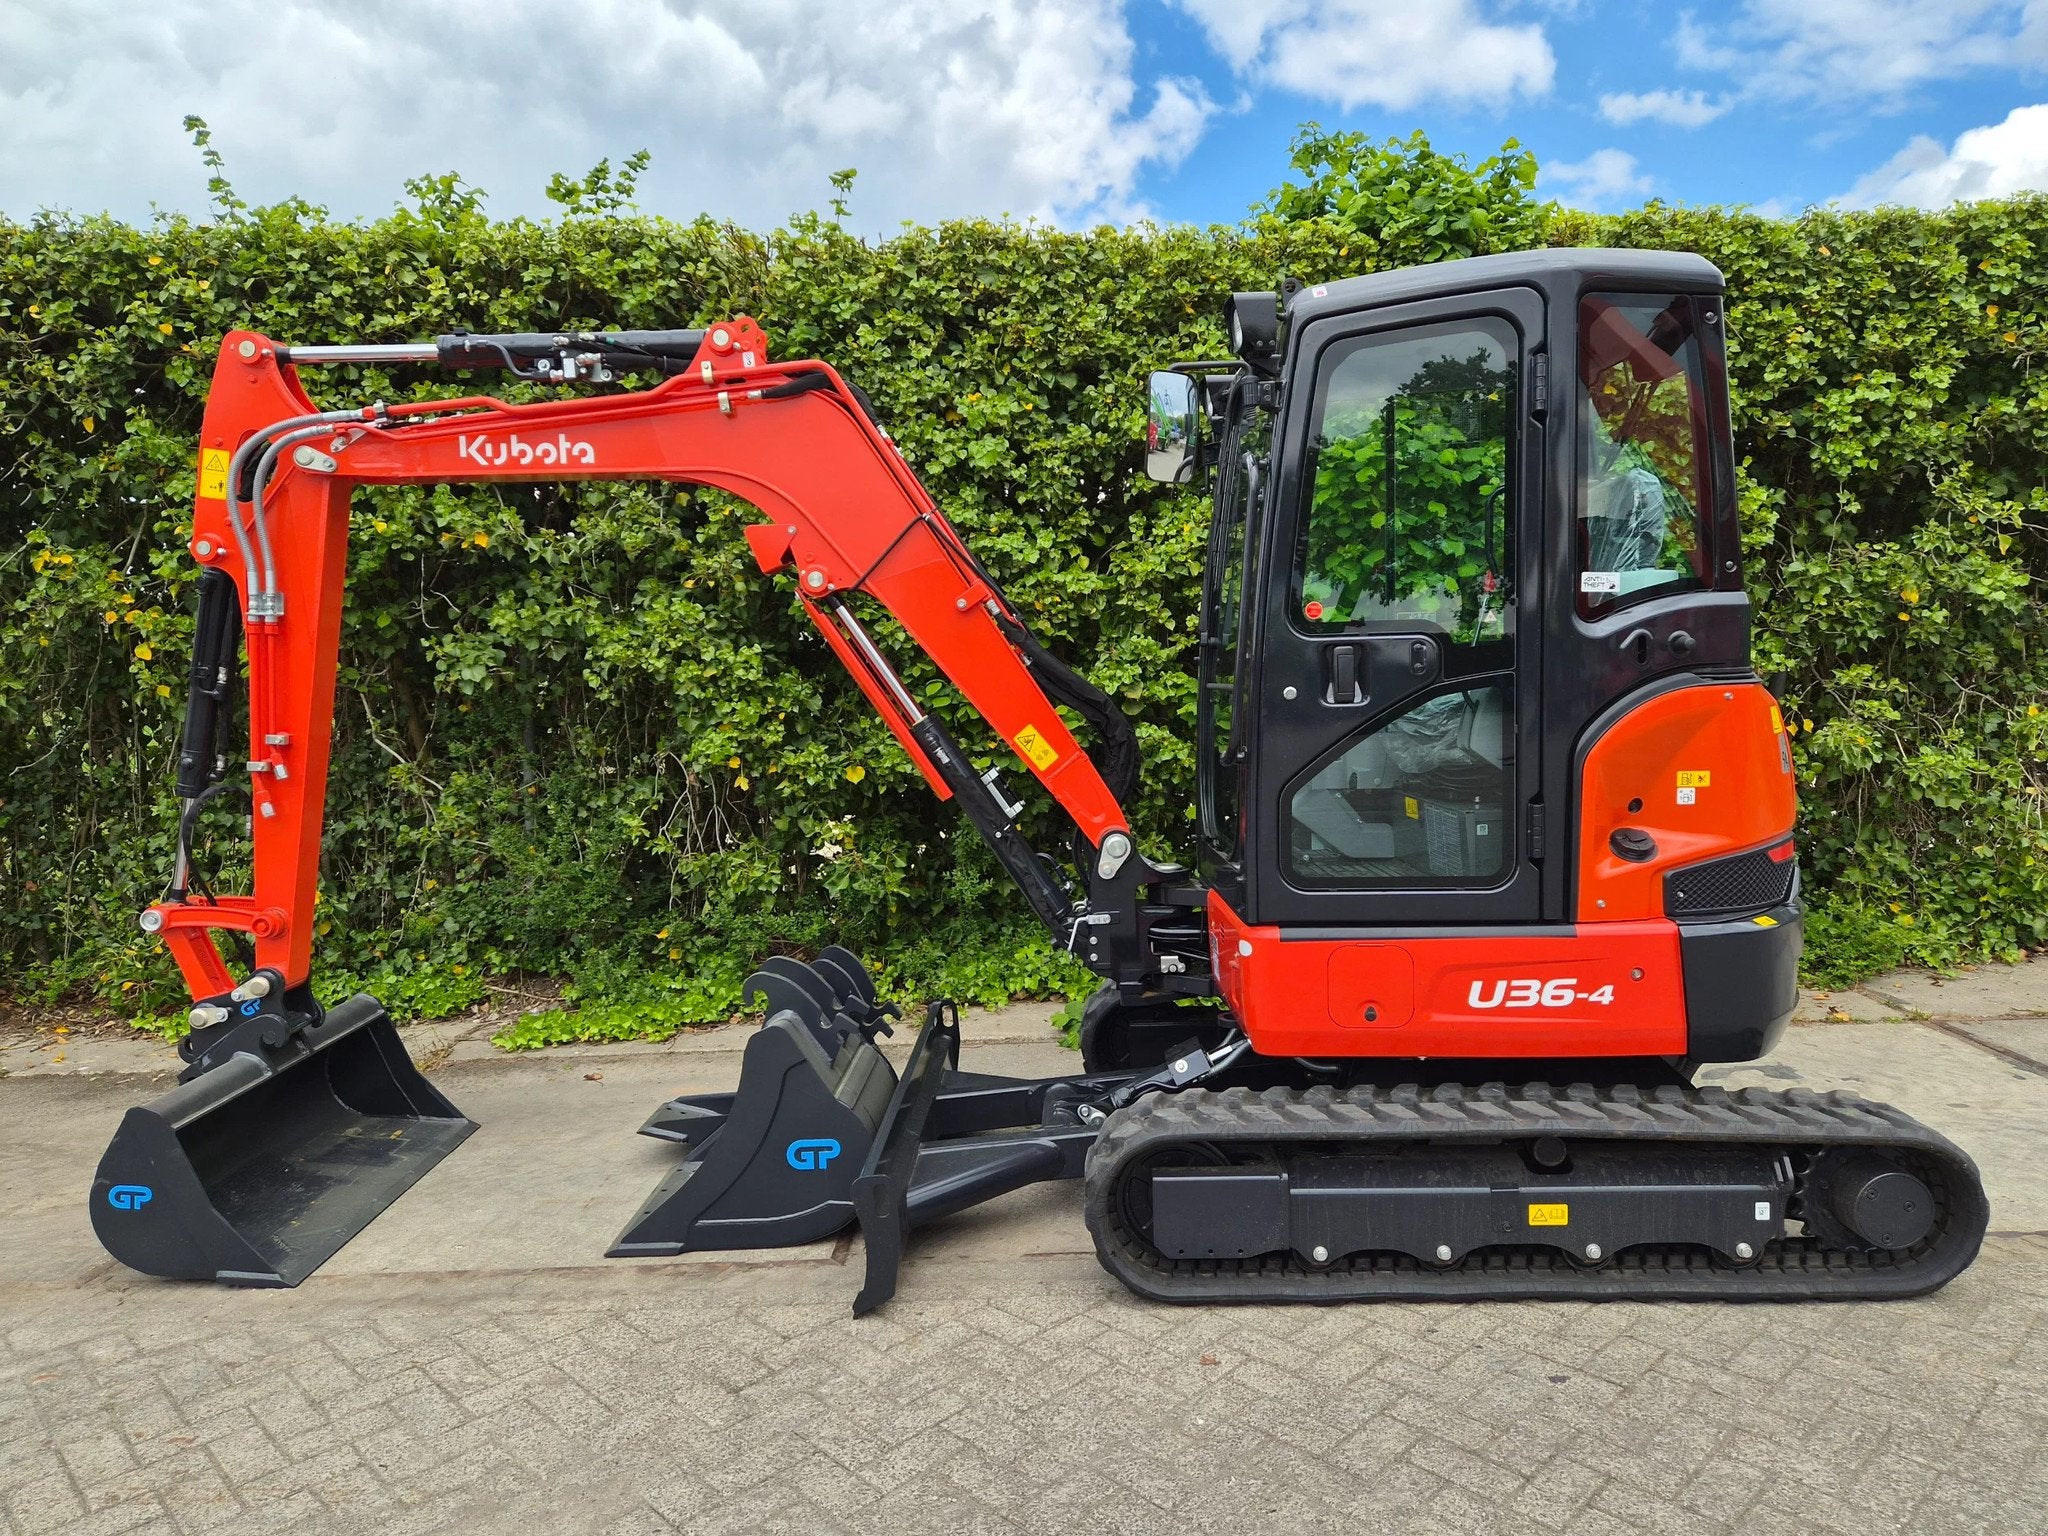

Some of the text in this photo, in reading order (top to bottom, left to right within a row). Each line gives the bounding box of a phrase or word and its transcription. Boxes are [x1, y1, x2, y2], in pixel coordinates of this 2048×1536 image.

[459, 434, 595, 466] Kubota
[1468, 978, 1615, 1009] U36-4
[786, 1138, 841, 1170] GP
[108, 1185, 152, 1210] GP
